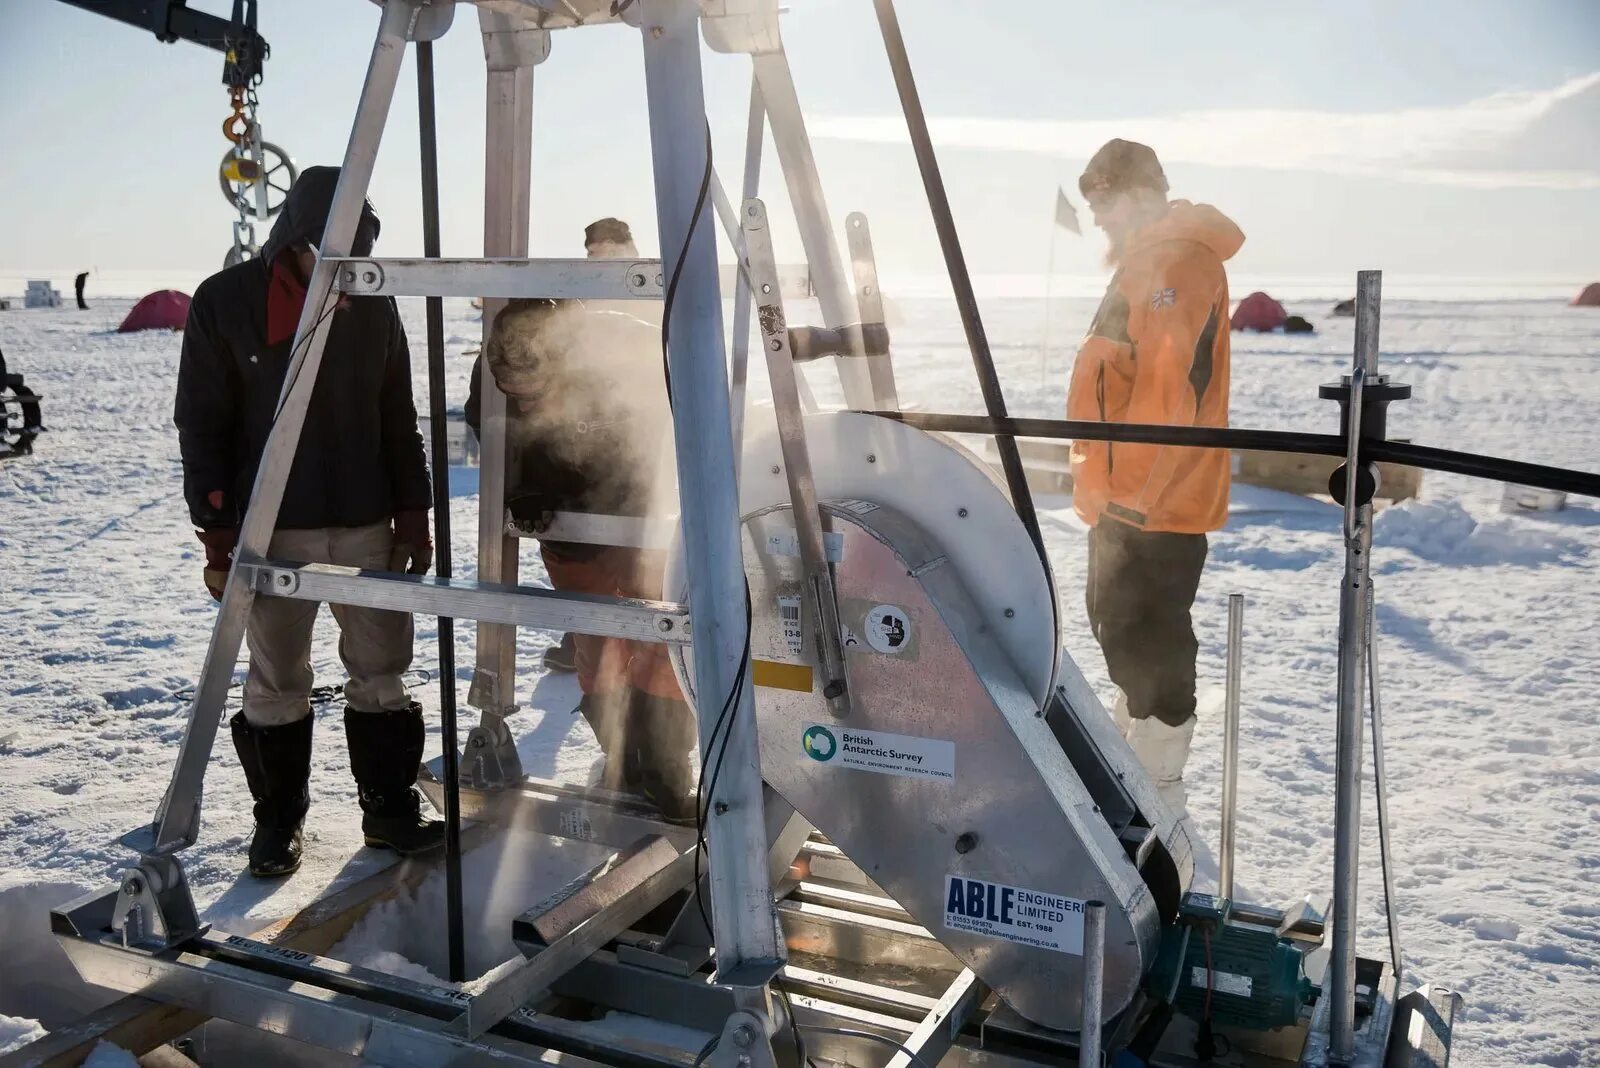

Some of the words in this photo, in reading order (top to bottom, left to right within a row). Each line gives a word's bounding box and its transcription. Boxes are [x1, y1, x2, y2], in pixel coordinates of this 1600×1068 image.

[843, 733, 873, 746] British
[843, 743, 888, 758] Antarctic
[889, 750, 923, 765] Survey
[844, 758, 866, 766] NATURAL
[868, 761, 903, 770] ENVIRONMENT
[931, 770, 953, 778] COUNCIL
[947, 878, 1015, 926] ABLE
[1018, 891, 1085, 914] ENGINEERI
[952, 915, 971, 924] 01553
[1017, 905, 1064, 923] LIMITED
[1016, 920, 1034, 929] EST.
[1036, 923, 1053, 933] 1988
